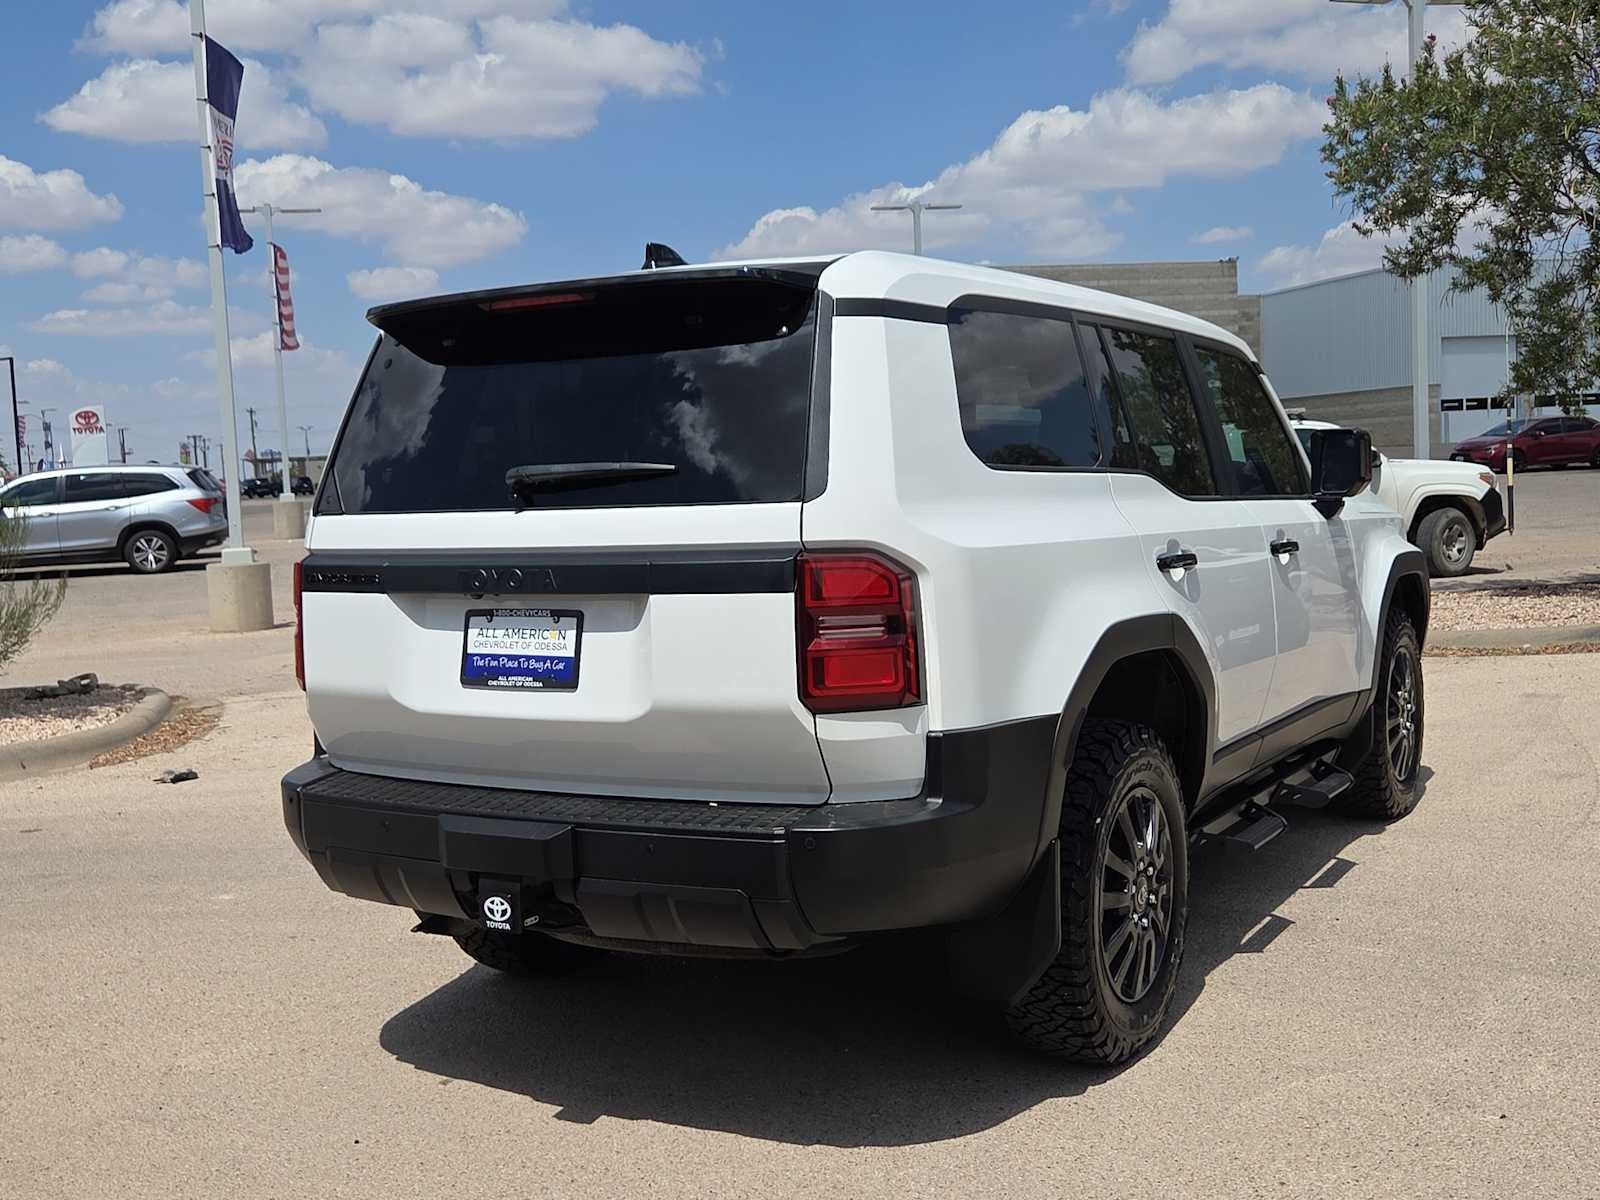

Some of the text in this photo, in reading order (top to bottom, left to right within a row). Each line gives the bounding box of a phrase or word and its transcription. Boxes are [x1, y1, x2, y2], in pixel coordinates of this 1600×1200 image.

[72, 425, 105, 435] TOYOTA
[477, 627, 567, 641] ALL AMERICN
[473, 640, 568, 651] CHEVROLET OF ODESSA
[473, 656, 566, 673] The Fun Place To Buy A Car
[485, 920, 511, 930] TOYOTA
